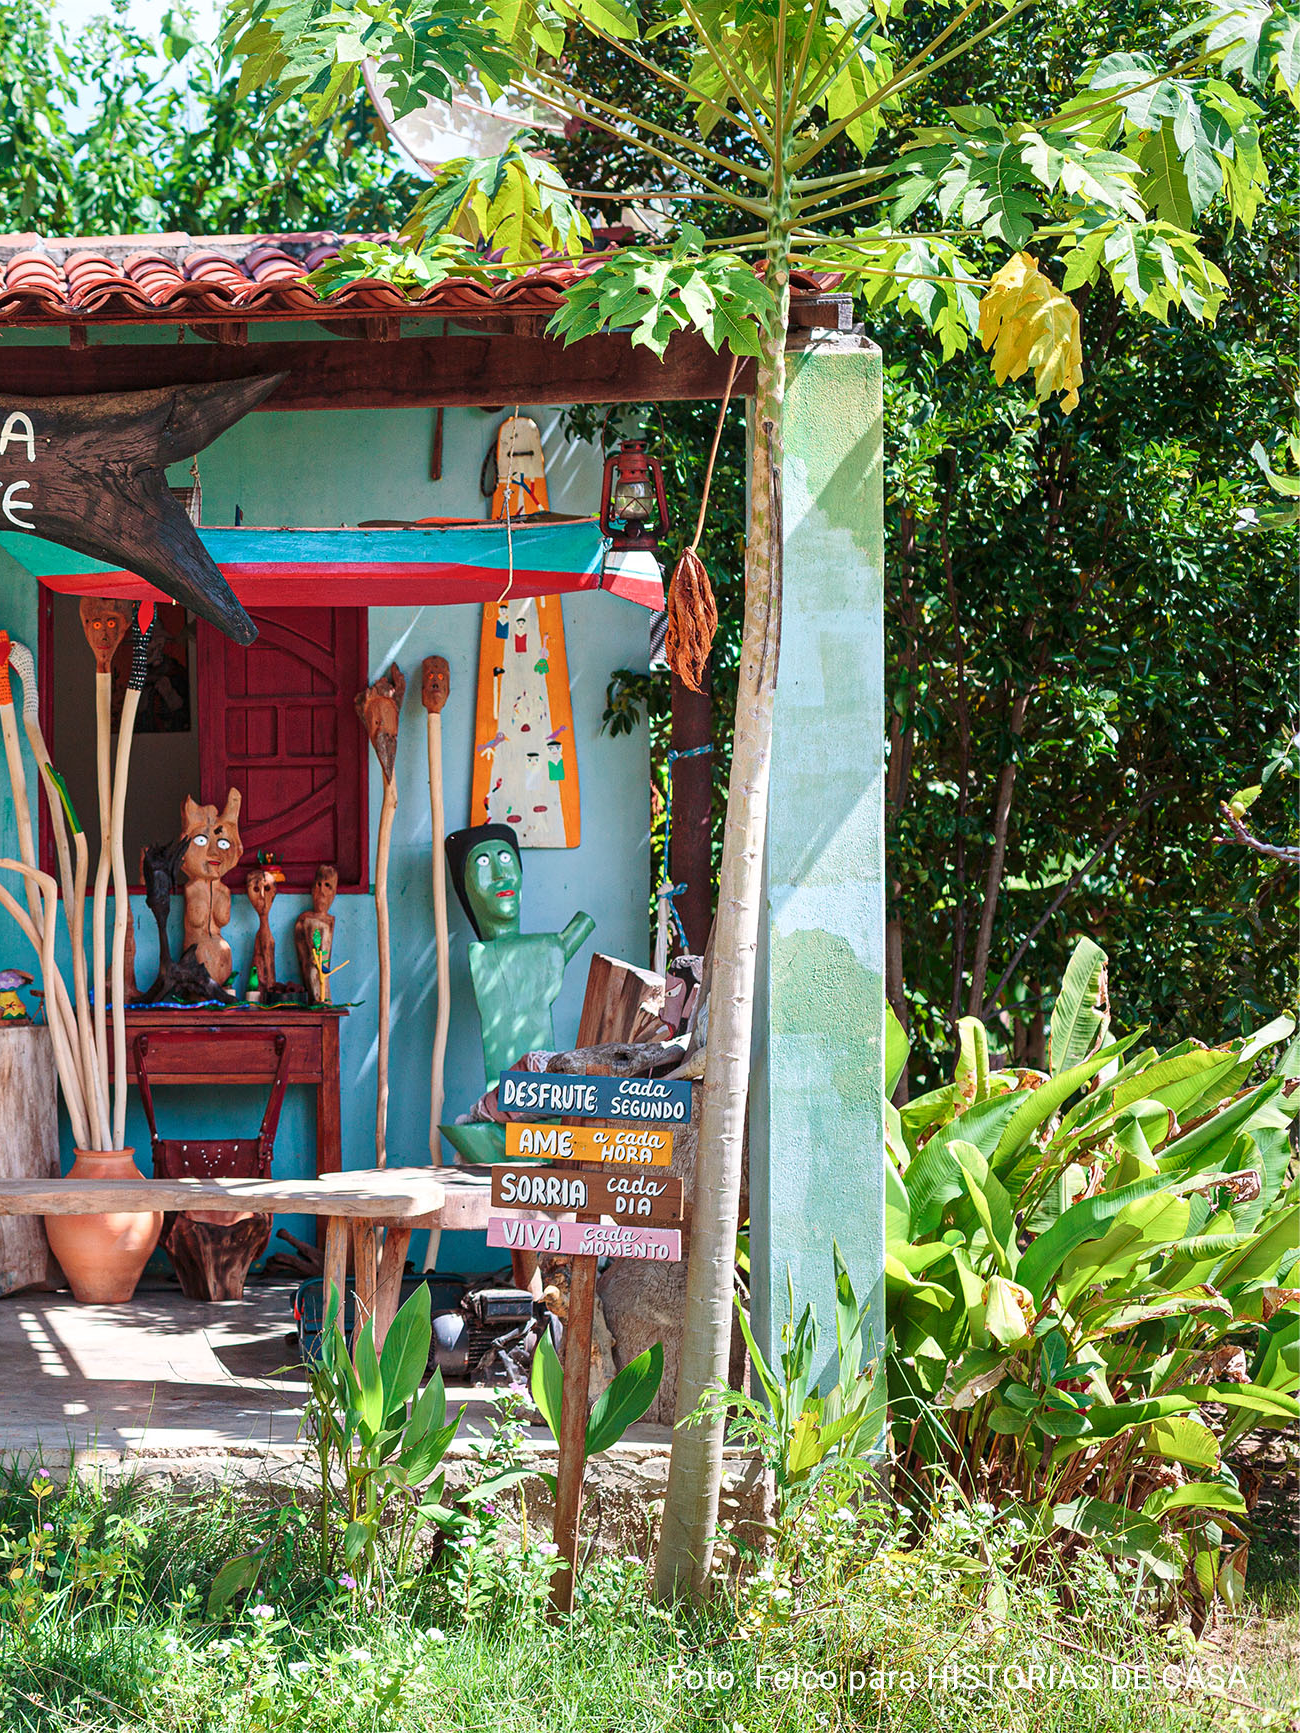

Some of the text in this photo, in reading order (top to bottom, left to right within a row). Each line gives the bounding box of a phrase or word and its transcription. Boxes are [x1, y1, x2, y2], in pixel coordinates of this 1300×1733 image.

[504, 1080, 672, 1114] DESFRUTE cada
[611, 1097, 685, 1120] SEGUNDO
[519, 1129, 666, 1157] AME a cada
[601, 1145, 653, 1163] HORA
[500, 1173, 667, 1208] SORRIA cada
[615, 1196, 652, 1216] DIA
[502, 1221, 641, 1250] VIVA cada
[579, 1242, 669, 1260] MOMENTO
